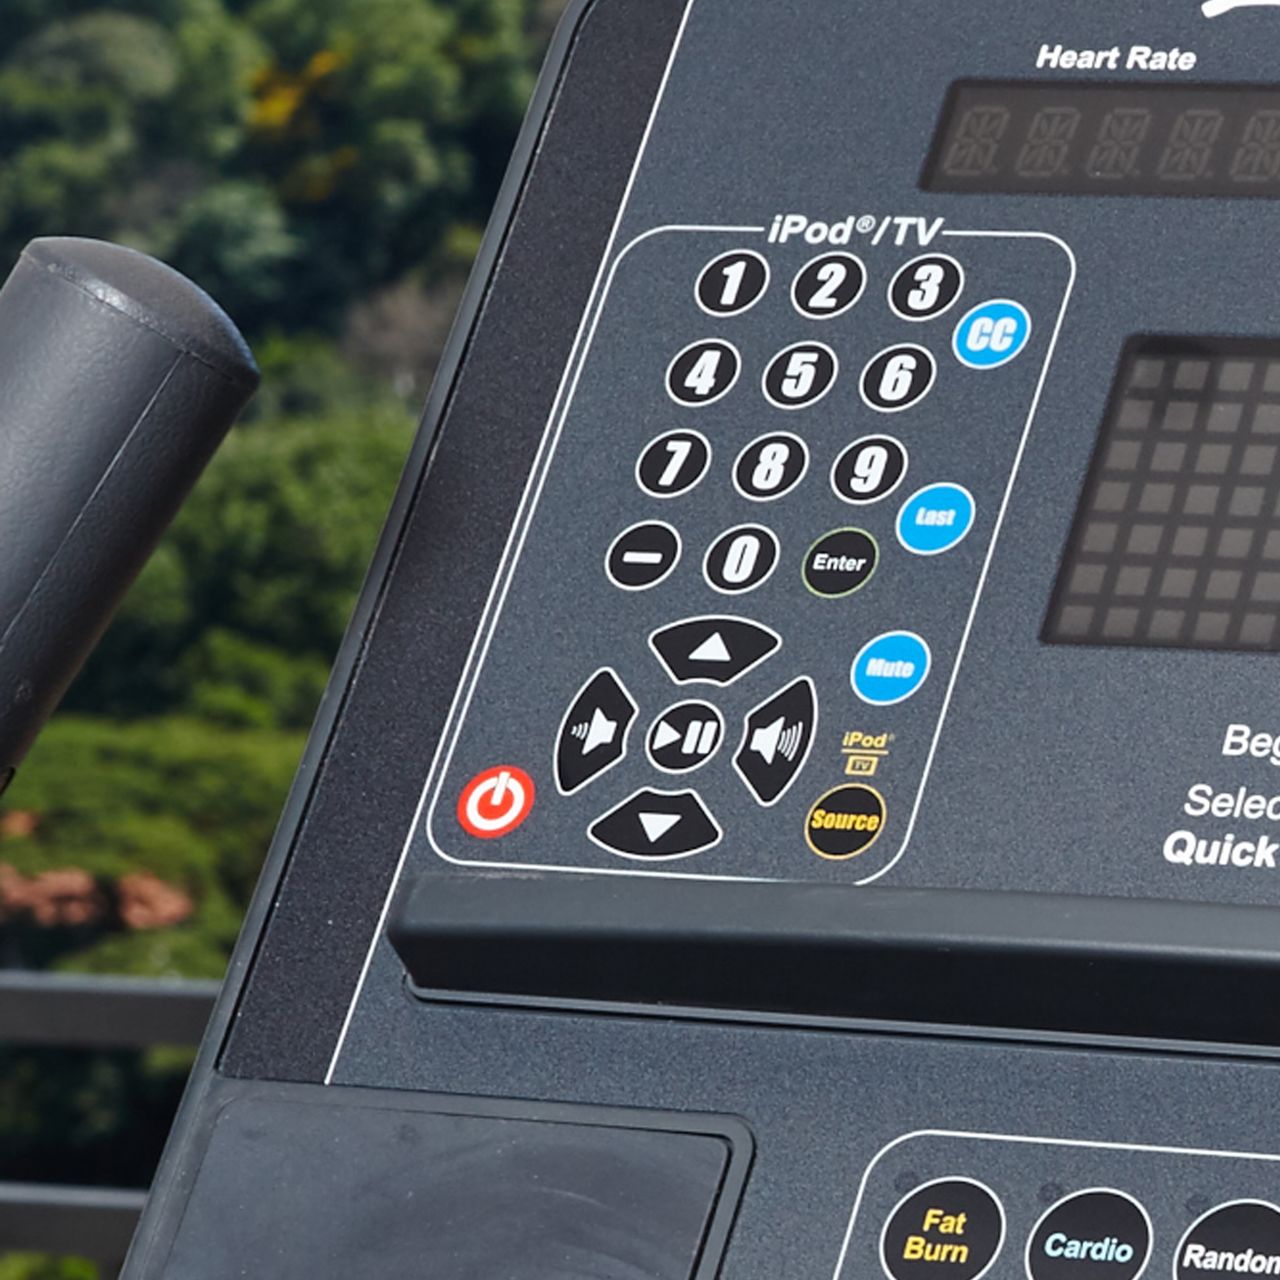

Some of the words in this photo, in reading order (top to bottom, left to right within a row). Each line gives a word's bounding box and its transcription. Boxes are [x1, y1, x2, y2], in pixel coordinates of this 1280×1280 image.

[1036, 45, 1121, 73] Heart
[1129, 46, 1198, 73] Rate
[722, 262, 746, 305] 1
[809, 264, 846, 307] 2
[908, 265, 944, 309] 3
[966, 317, 1018, 352] CC
[685, 354, 716, 396] 4
[782, 354, 819, 398] 5
[880, 355, 915, 400] 6
[657, 441, 691, 485] 7
[754, 444, 788, 491] 8
[853, 446, 887, 493] 9
[916, 507, 956, 527] Last
[724, 536, 758, 583] 0
[812, 553, 867, 573] Enter
[866, 658, 915, 679] Mute
[854, 761, 870, 771] TV
[811, 808, 880, 832] Source
[1163, 830, 1280, 868] Quick
[922, 1209, 967, 1236] Fat
[902, 1236, 969, 1265] Burn
[1043, 1234, 1135, 1263] Cardio
